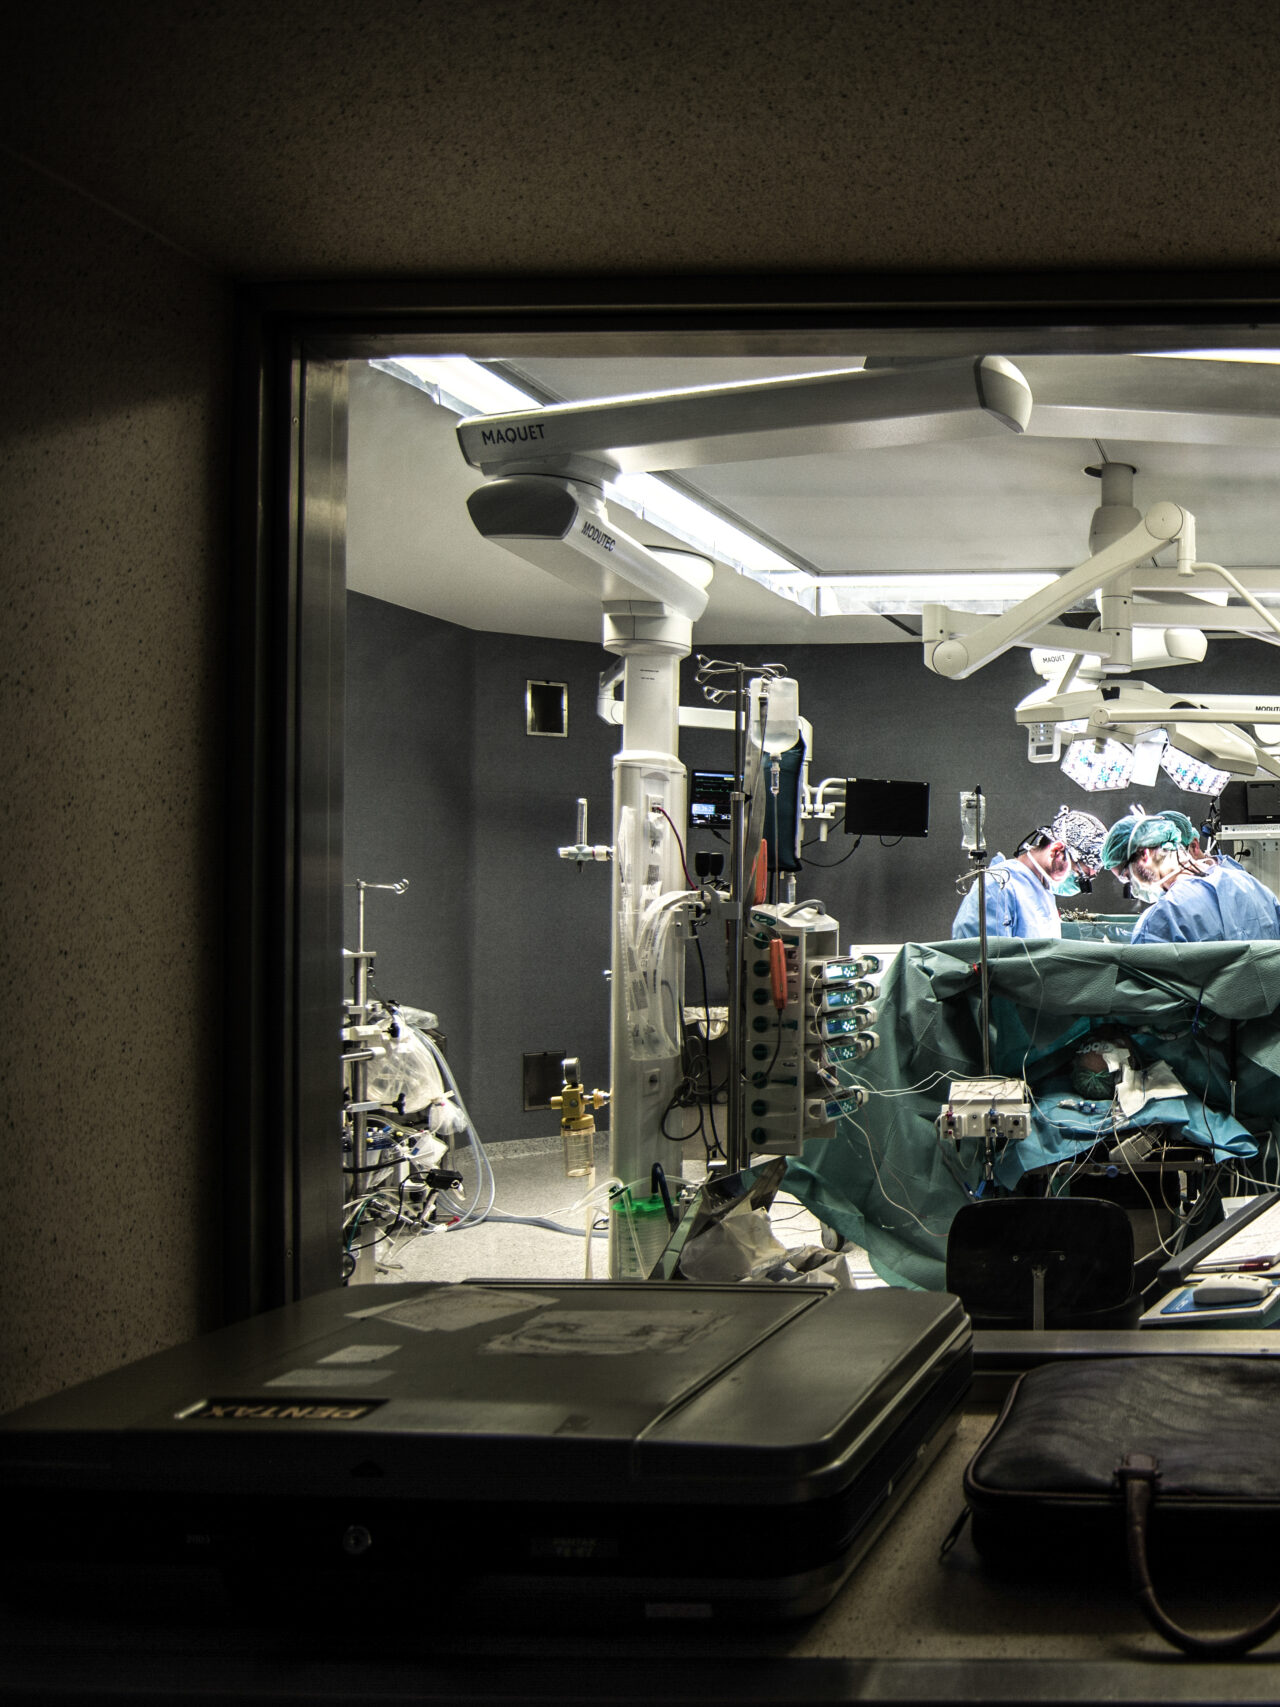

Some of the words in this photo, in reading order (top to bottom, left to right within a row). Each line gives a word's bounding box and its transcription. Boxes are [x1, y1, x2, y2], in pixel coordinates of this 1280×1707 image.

[481, 424, 545, 446] MAQUET
[581, 521, 616, 552] MODUTEC
[1042, 654, 1065, 663] MAQUET
[203, 1405, 367, 1419] PENTAX
